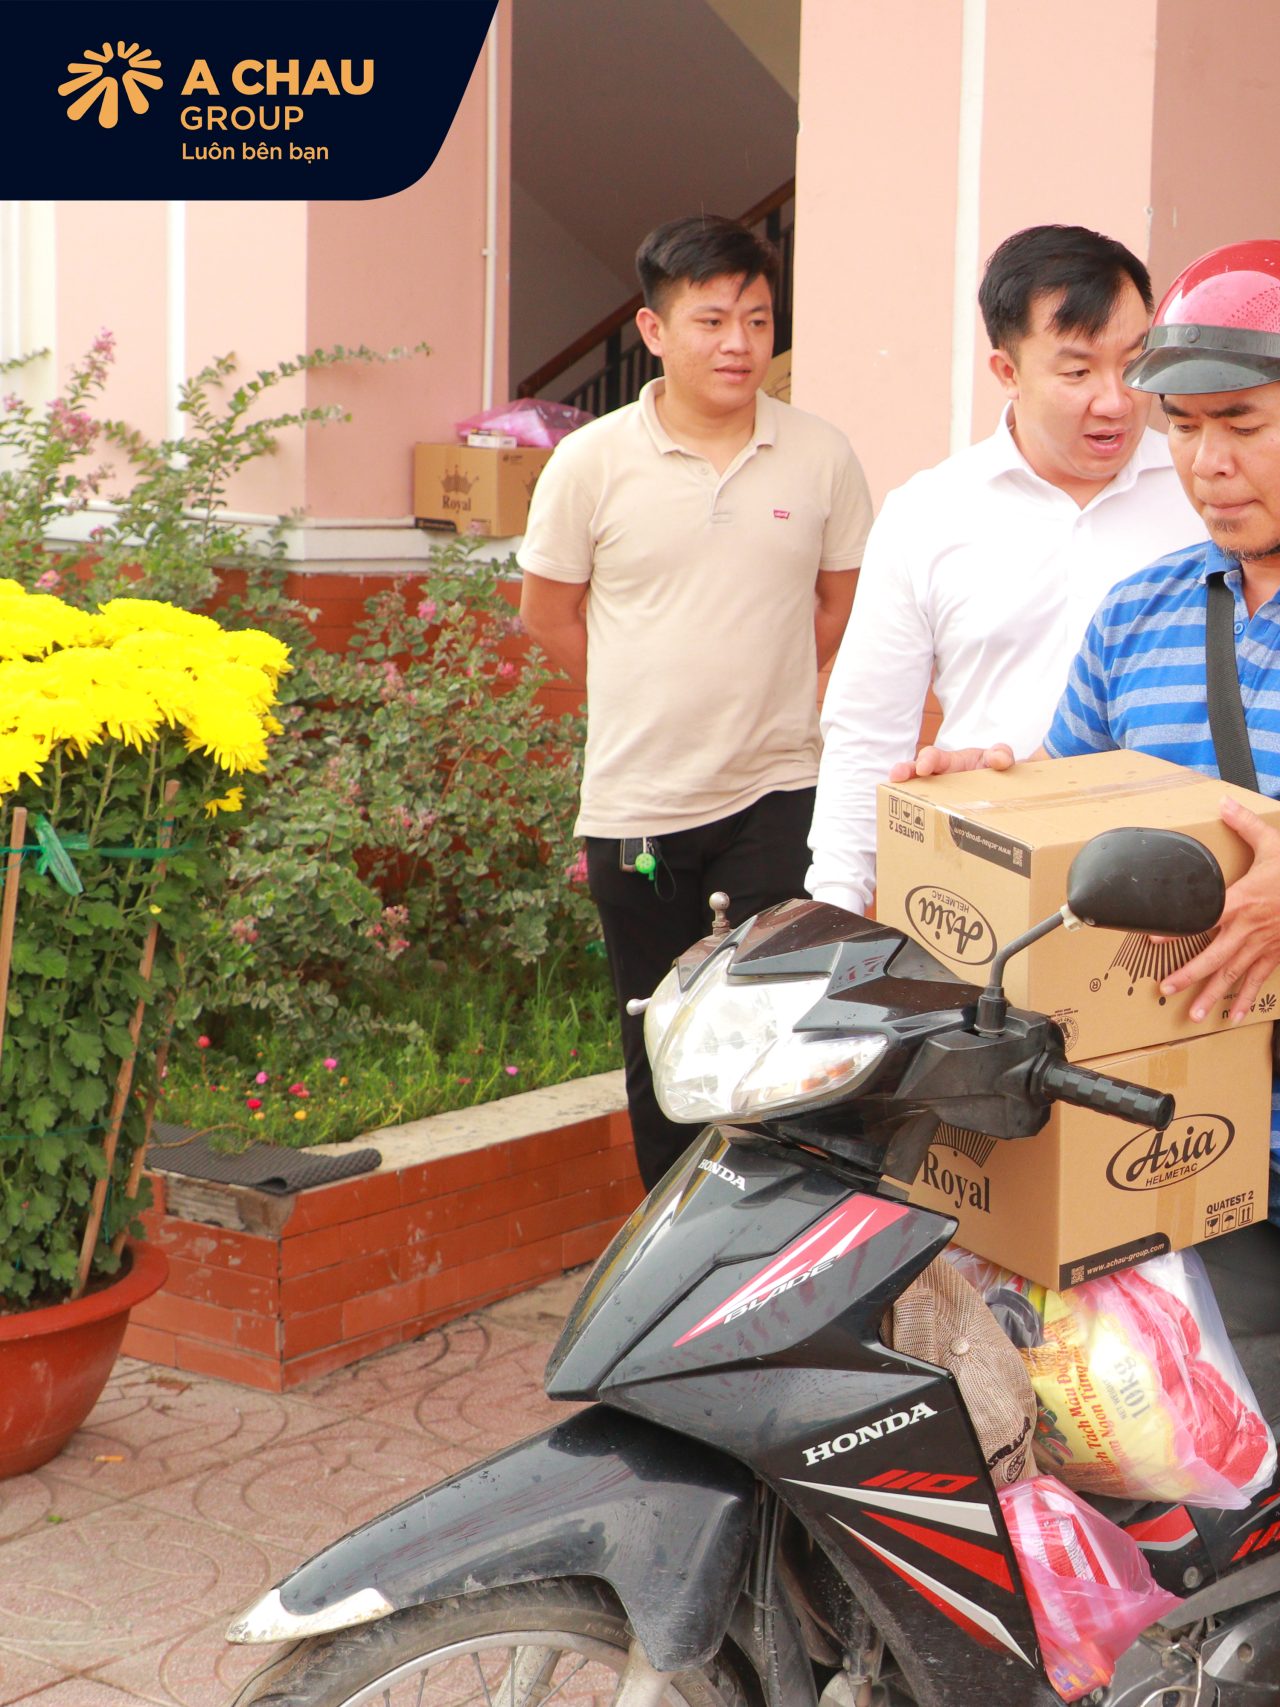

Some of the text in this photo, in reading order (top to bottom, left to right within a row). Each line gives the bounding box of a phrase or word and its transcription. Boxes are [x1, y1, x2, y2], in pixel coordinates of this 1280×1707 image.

[442, 495, 472, 514] Royal
[888, 820, 925, 844] QUATEST 2
[932, 890, 970, 913] HELMETAC
[918, 898, 984, 955] Asia
[1126, 1126, 1217, 1183] Asia
[698, 1158, 746, 1191] HONDA
[922, 1151, 991, 1213] Royal
[1145, 1163, 1199, 1188] HELMETAC
[1206, 1191, 1254, 1215] QUATEST 2
[1087, 1242, 1165, 1276] www.achau-group.com
[724, 1254, 840, 1325] BLADE
[1114, 1356, 1151, 1418] 10kg
[802, 1402, 938, 1466] HONDA
[858, 1468, 979, 1495] 110
